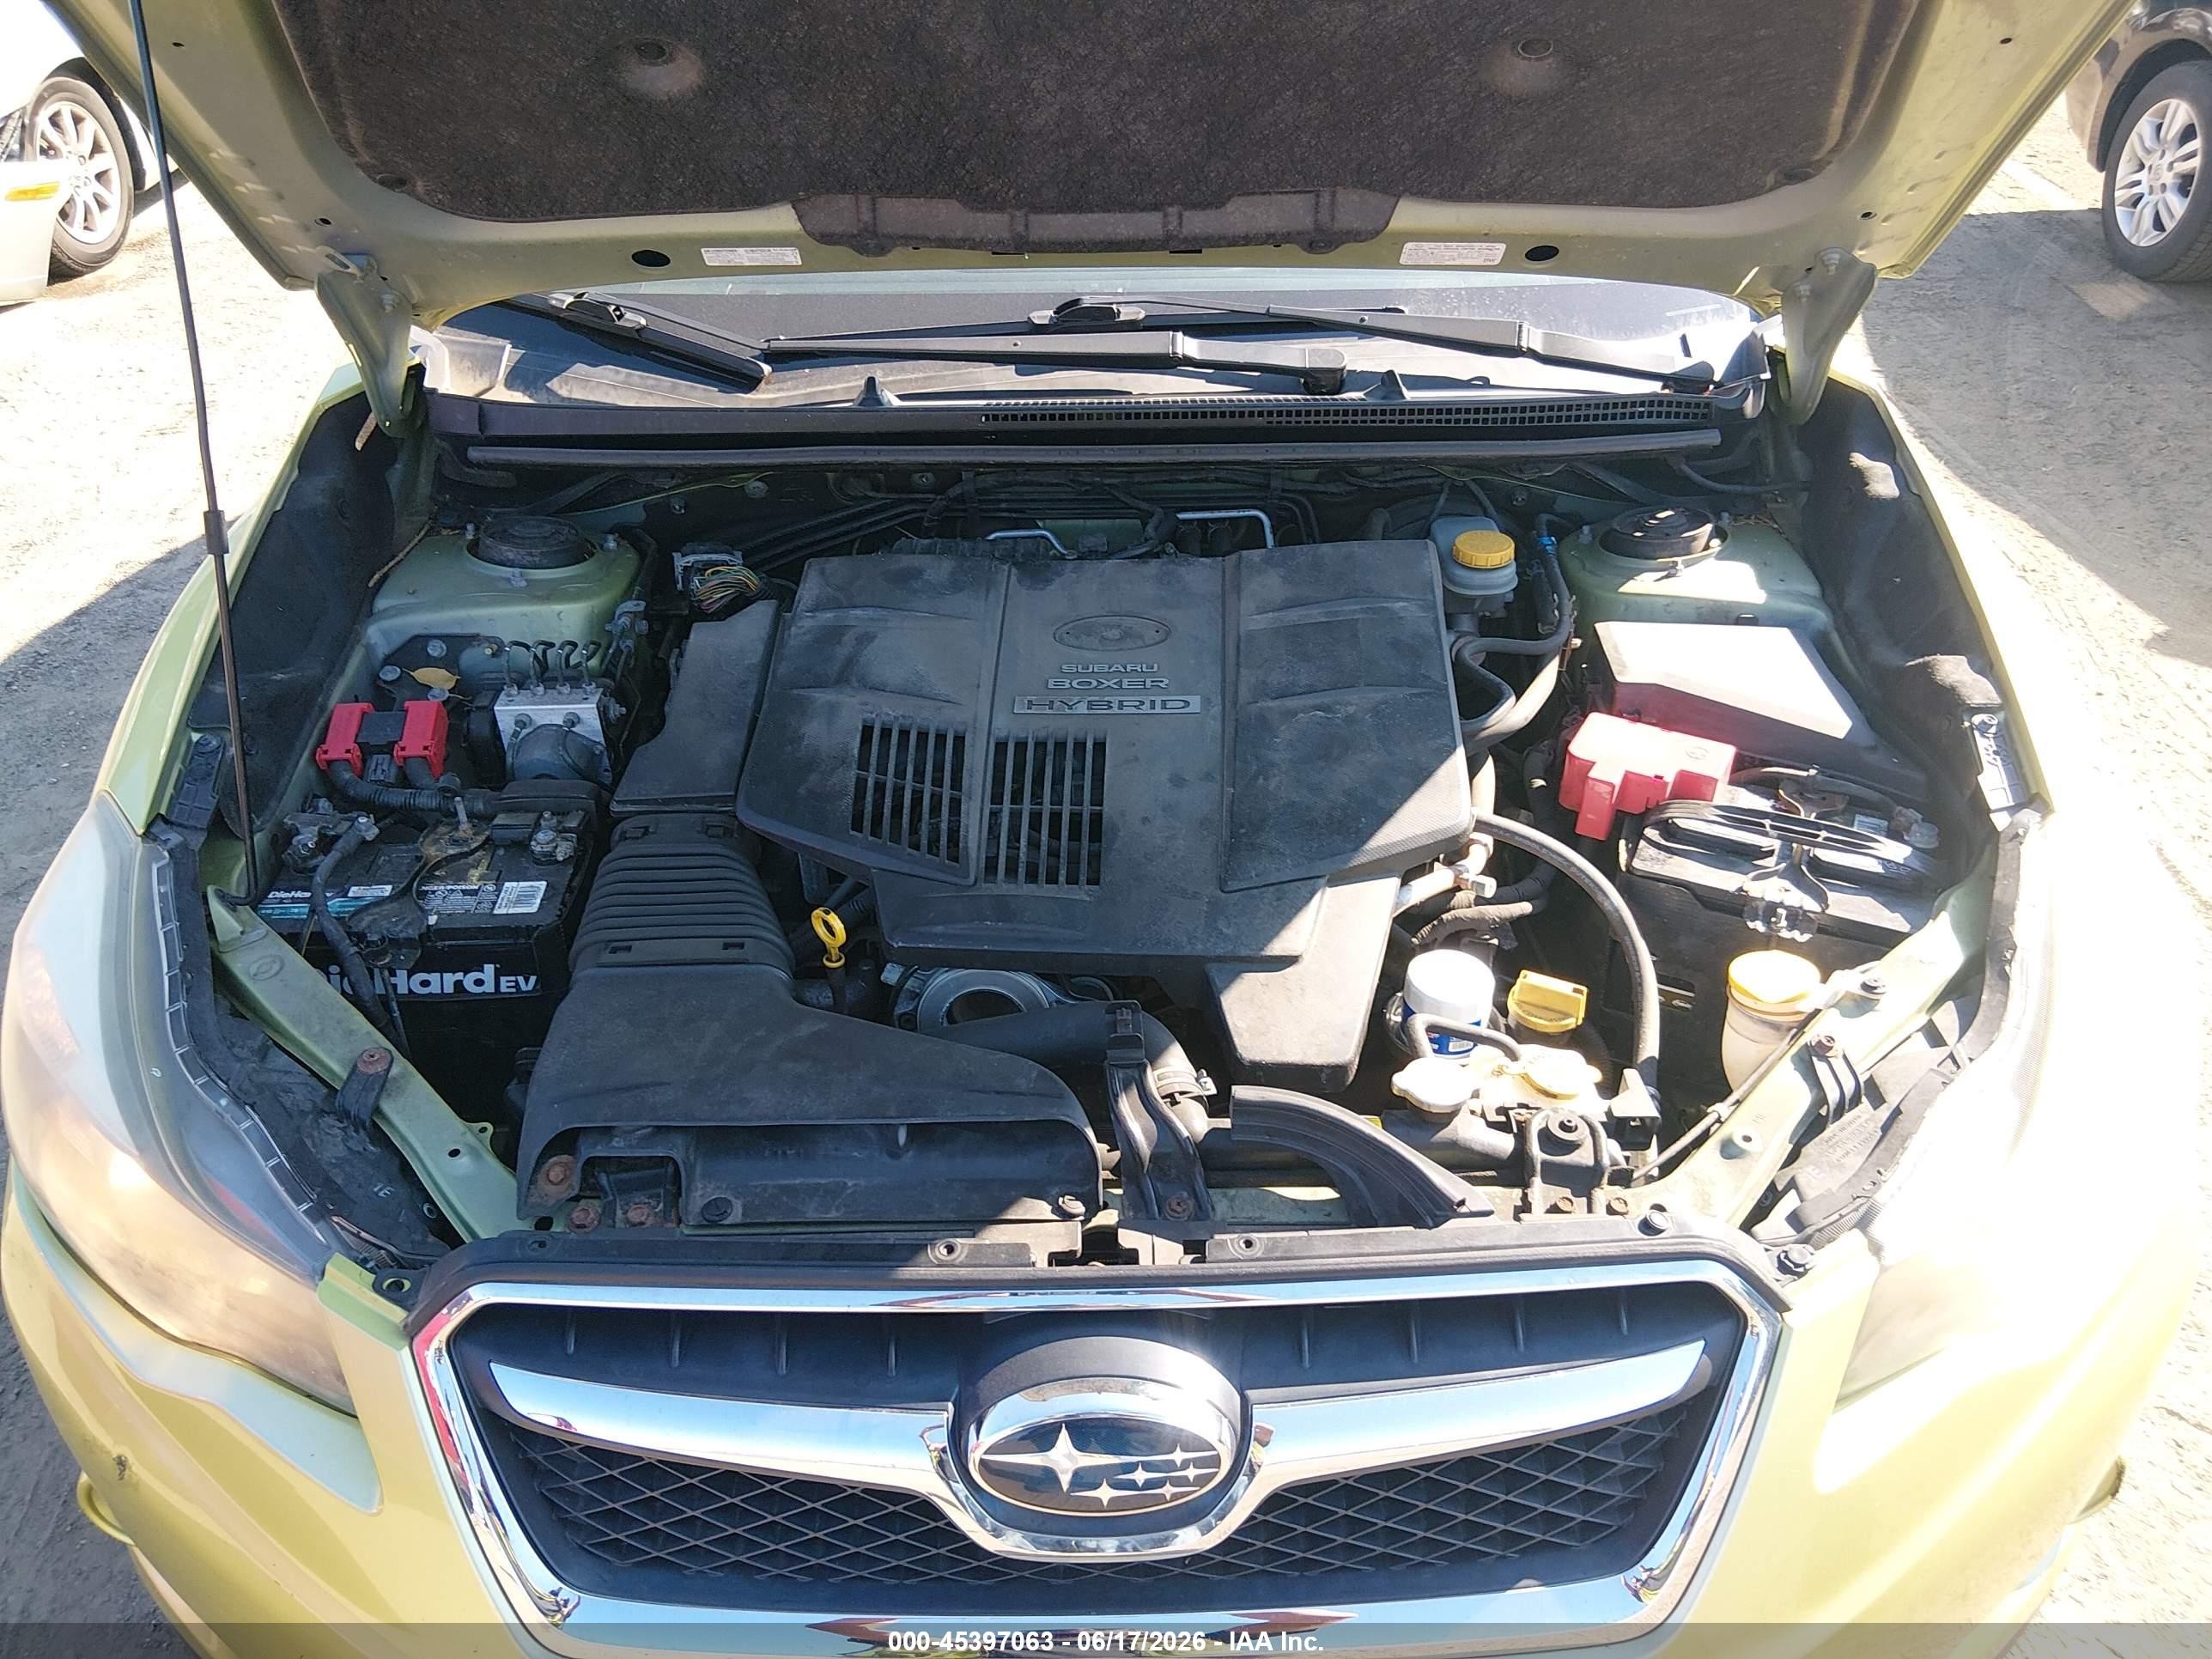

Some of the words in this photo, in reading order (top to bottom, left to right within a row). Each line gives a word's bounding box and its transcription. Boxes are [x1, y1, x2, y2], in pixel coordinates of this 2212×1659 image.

[1060, 663, 1158, 674] SUBARU
[1047, 678, 1170, 690] BOXER
[1025, 699, 1192, 711] HYBRID
[318, 963, 495, 994] iHard
[499, 975, 538, 993] EV
